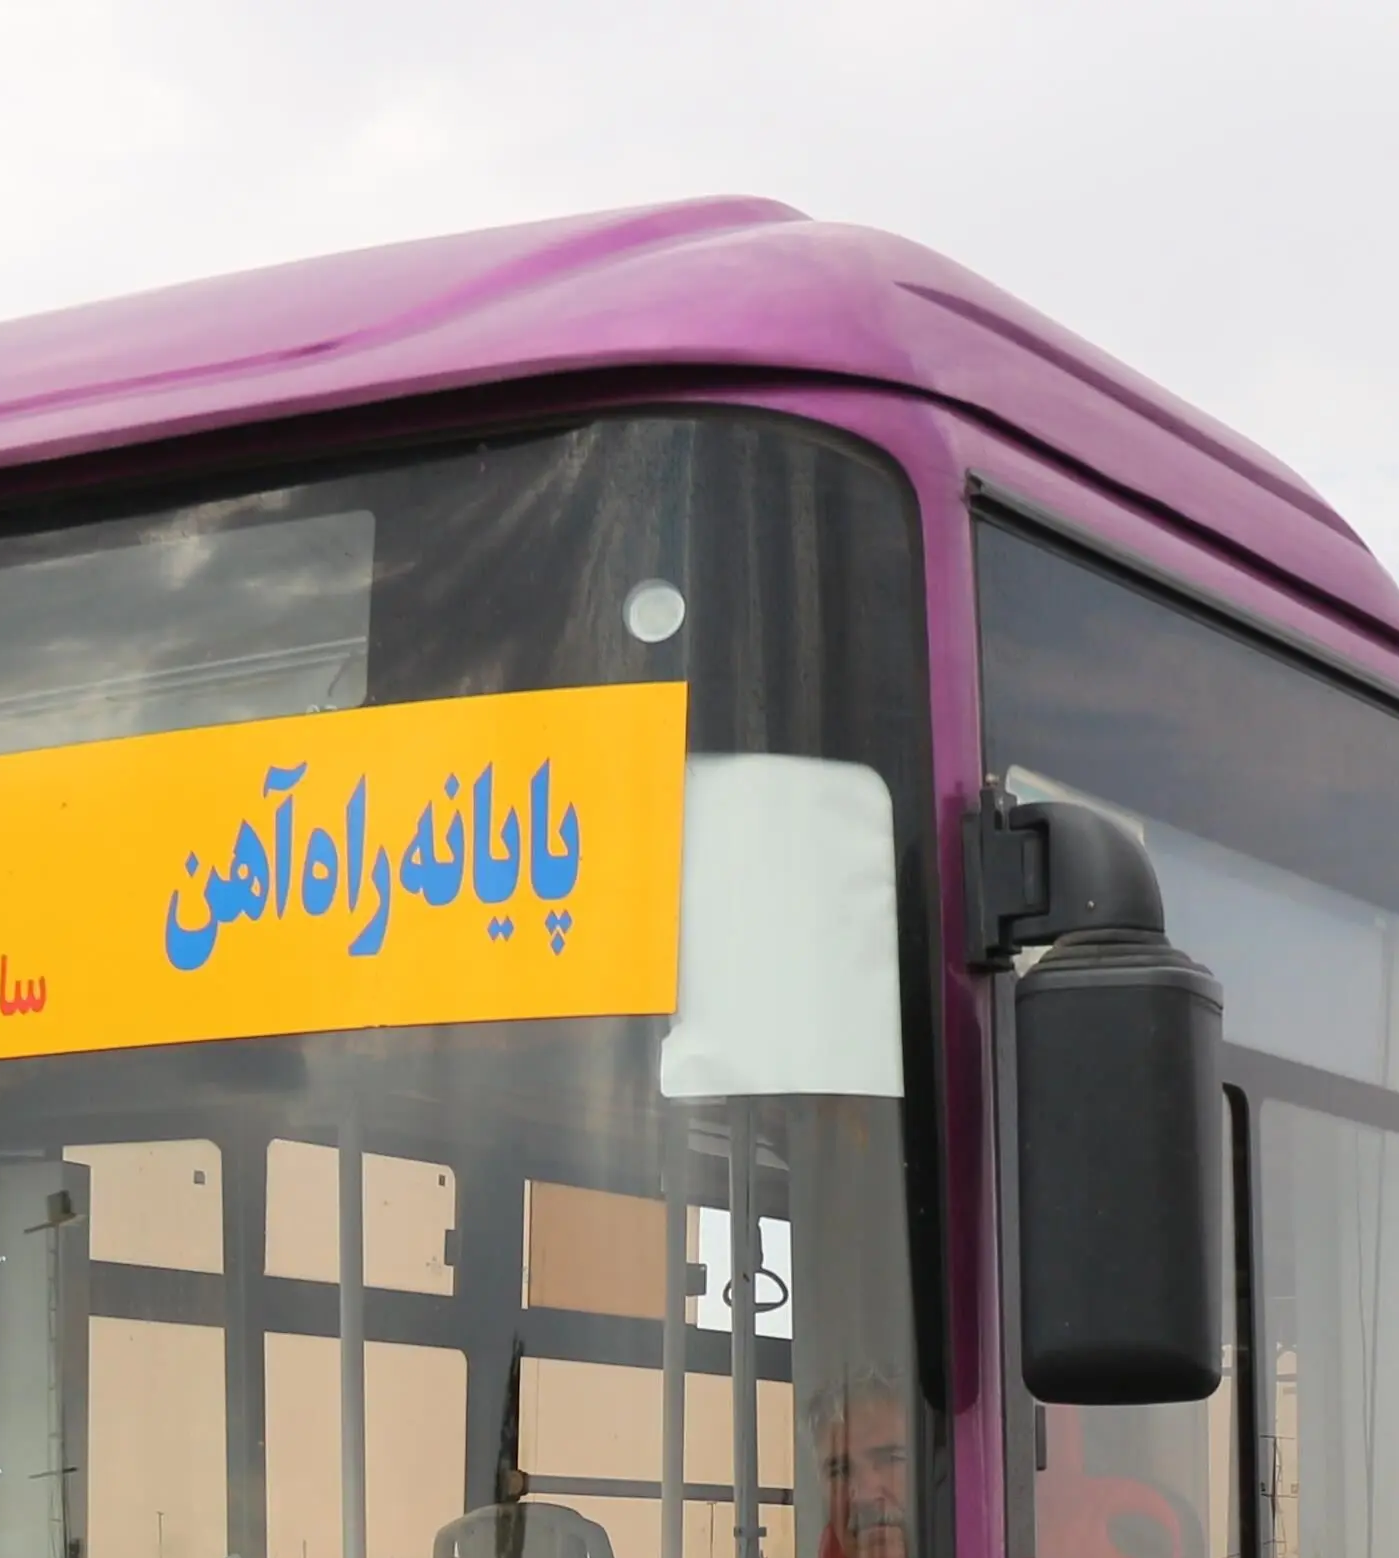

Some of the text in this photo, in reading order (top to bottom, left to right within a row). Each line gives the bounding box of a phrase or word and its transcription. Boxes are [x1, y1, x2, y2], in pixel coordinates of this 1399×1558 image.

[164, 757, 582, 973] پایانه راه آهن
